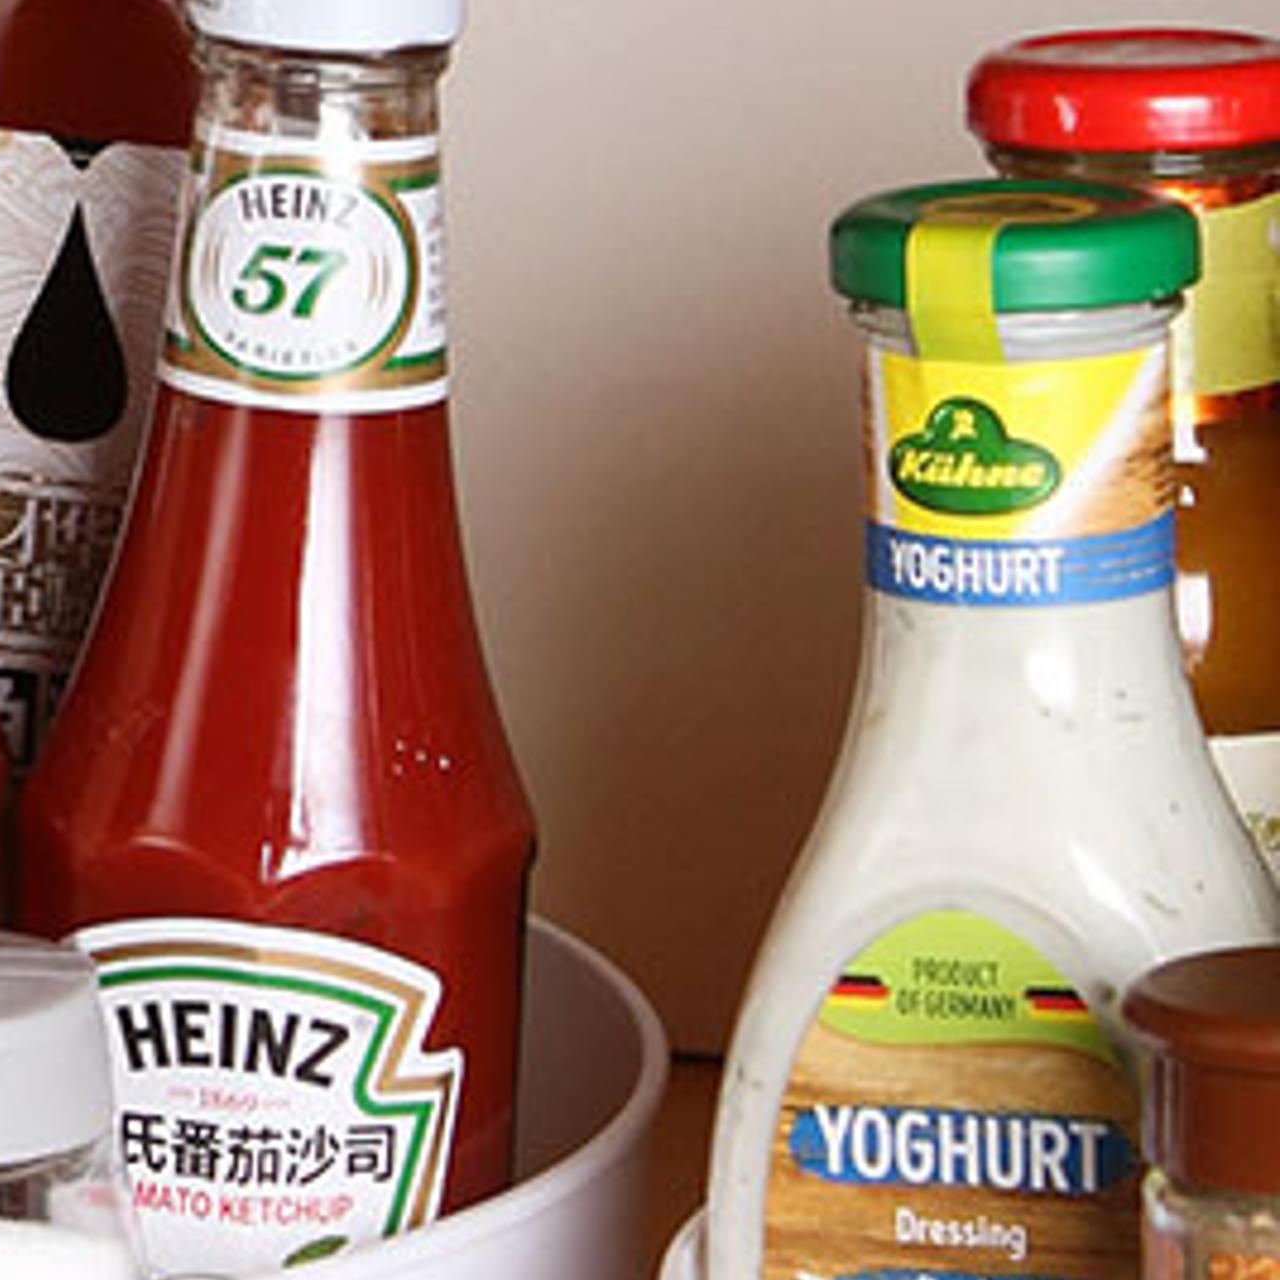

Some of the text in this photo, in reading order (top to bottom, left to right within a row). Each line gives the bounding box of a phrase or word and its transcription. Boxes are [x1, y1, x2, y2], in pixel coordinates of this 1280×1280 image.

[239, 182, 359, 228] HEINZ
[231, 242, 349, 319] 57
[889, 537, 1064, 596] YOGHURT
[912, 957, 999, 987] PRODUCT
[895, 990, 1018, 1021] OF GERMANY
[116, 1000, 350, 1089] HEINZ
[121, 1111, 397, 1187] 氏番茄沙司
[814, 1103, 1109, 1194] YOGHURT
[132, 1182, 354, 1228] MATO KETCHUP
[895, 1205, 1028, 1261] Dressing
